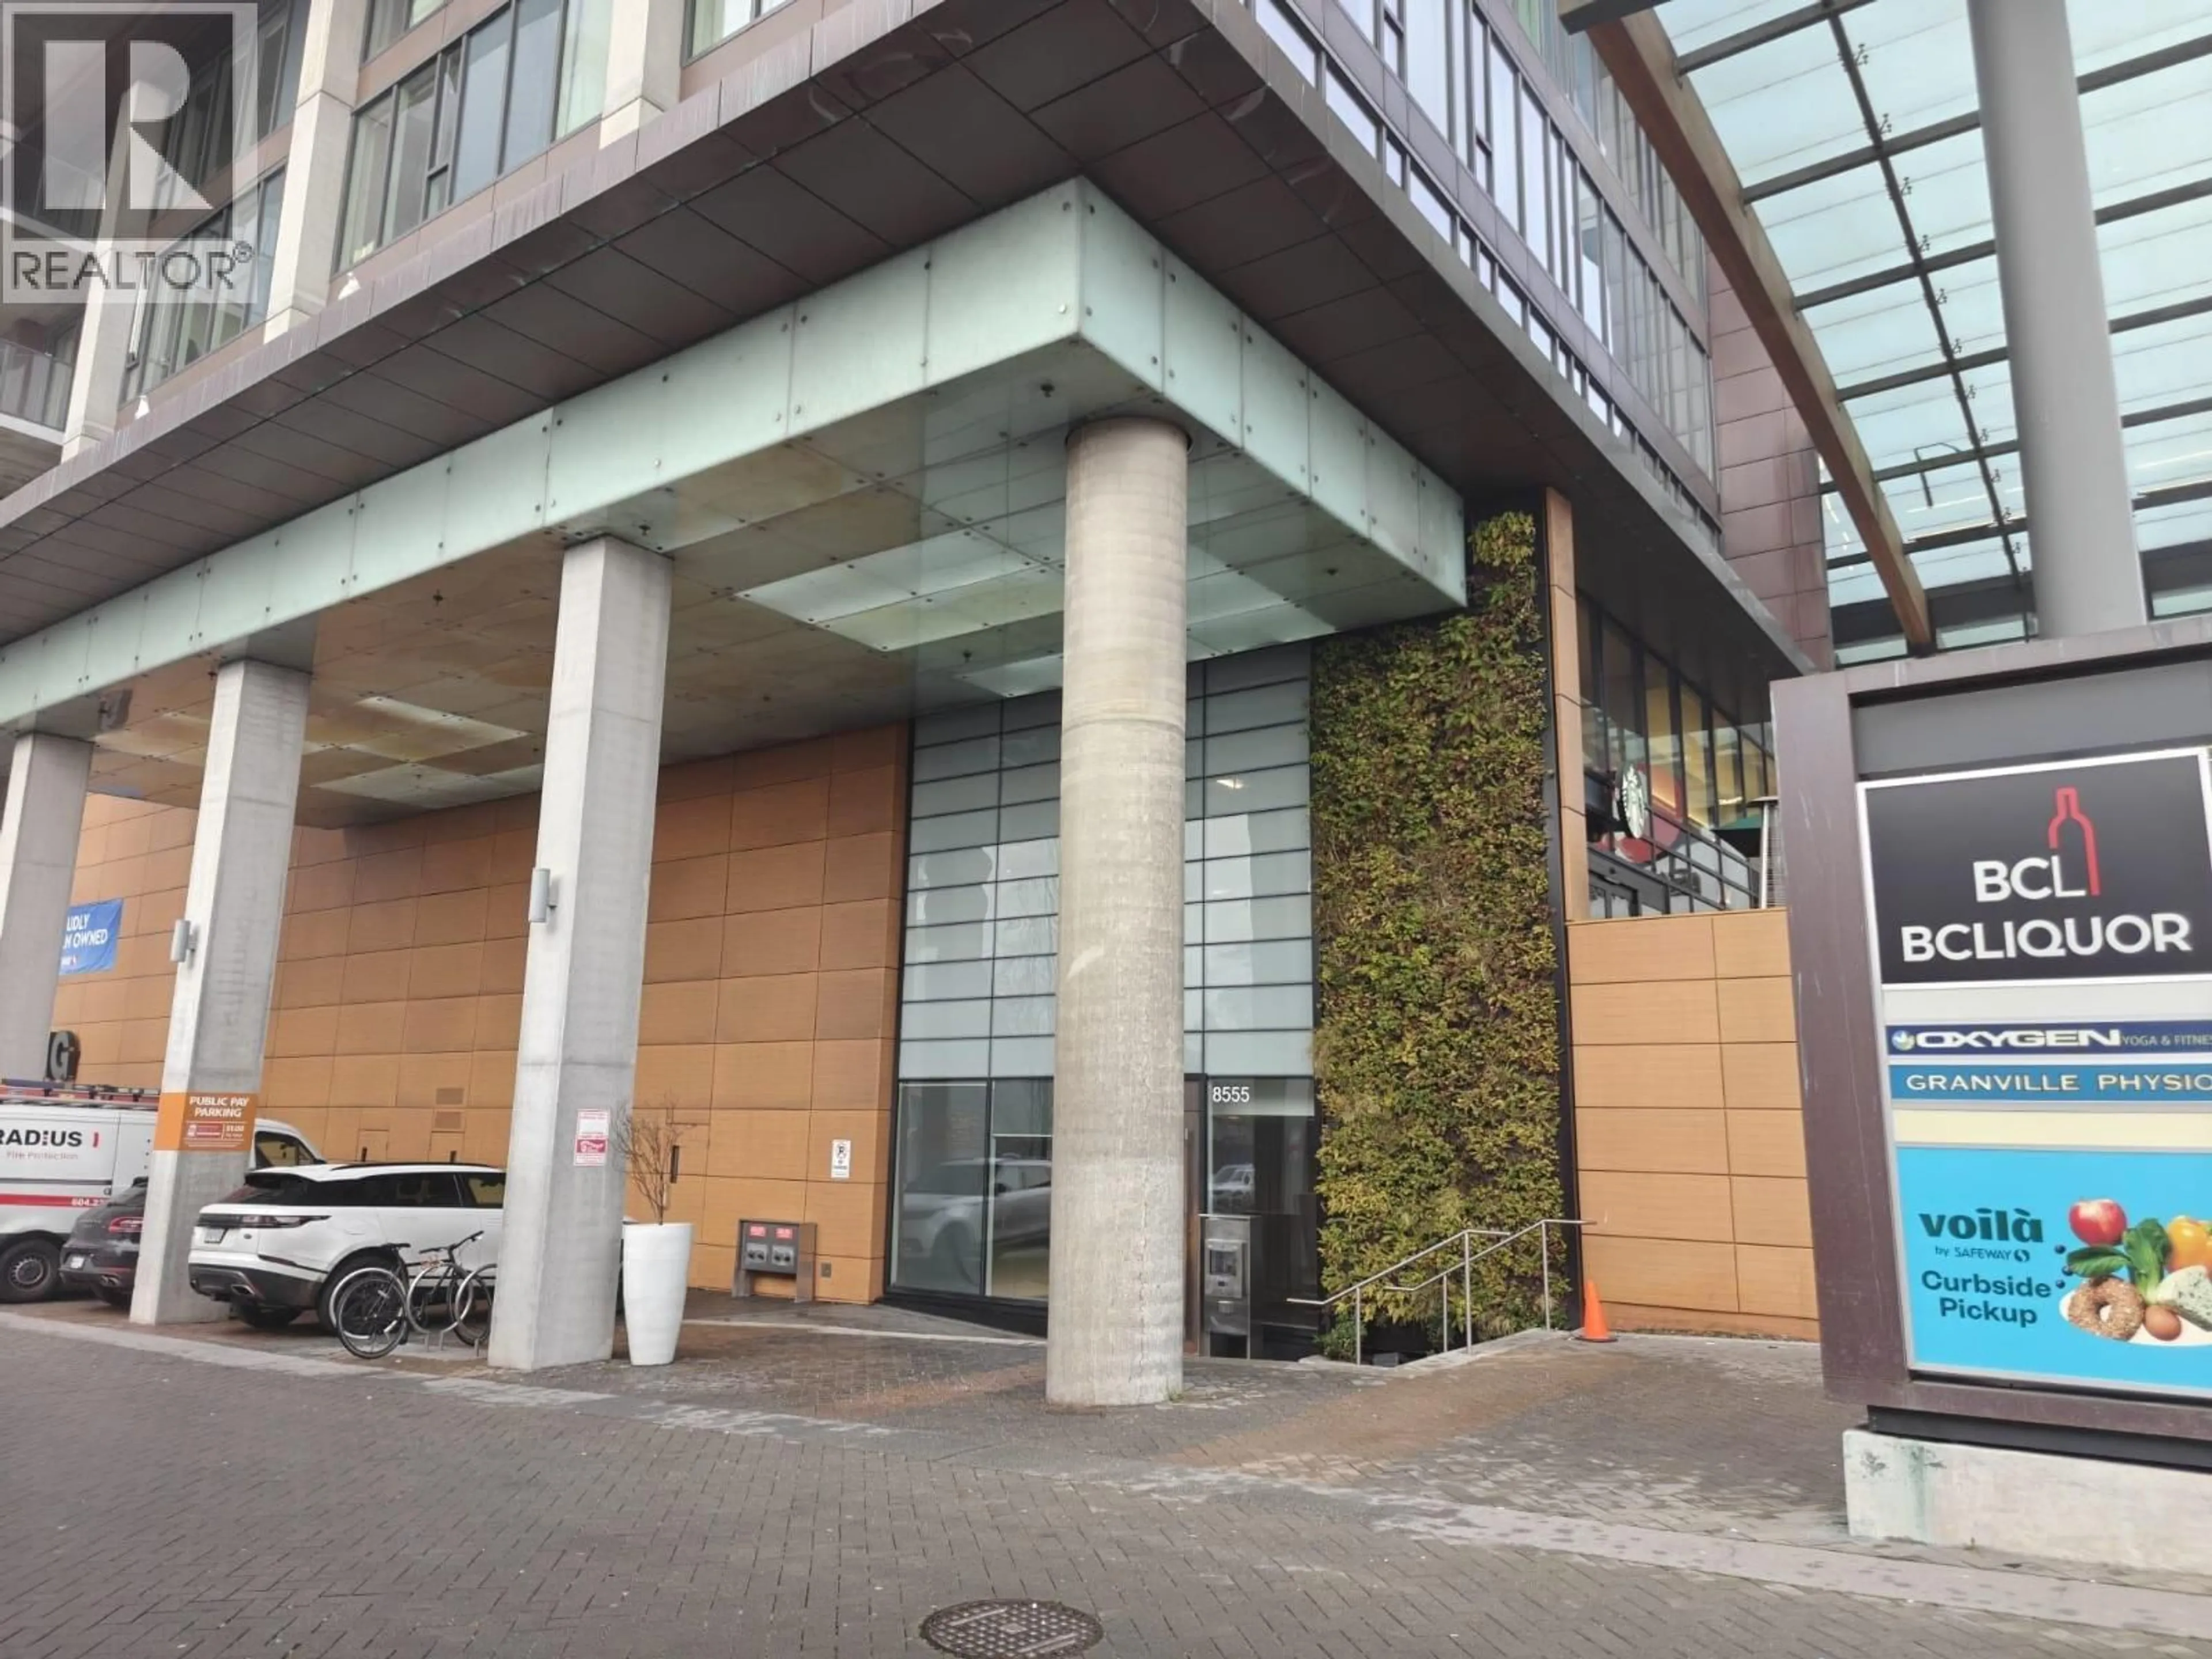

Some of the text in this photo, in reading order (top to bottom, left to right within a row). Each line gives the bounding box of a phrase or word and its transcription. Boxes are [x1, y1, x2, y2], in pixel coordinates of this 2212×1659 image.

[1972, 855, 2086, 903] BCL
[66, 913, 90, 931] UDLY
[73, 929, 108, 948] OWNED
[1901, 913, 2192, 962] BCLIQUOR
[1916, 1029, 2122, 1048] OXYGEN
[2123, 1035, 2158, 1047] YOGA
[2161, 1035, 2171, 1046] &
[1906, 1074, 2212, 1091] GRANVILLE PHYSIO
[189, 1096, 250, 1107] PUBLIC PAY
[1212, 1086, 1249, 1103] 8555
[195, 1107, 242, 1117] PARKING
[1918, 1207, 2044, 1243] voilà
[1935, 1245, 2012, 1260] by SAFEWAY
[1921, 1270, 2052, 1298] Curbside
[1939, 1297, 2038, 1328] Pickup
